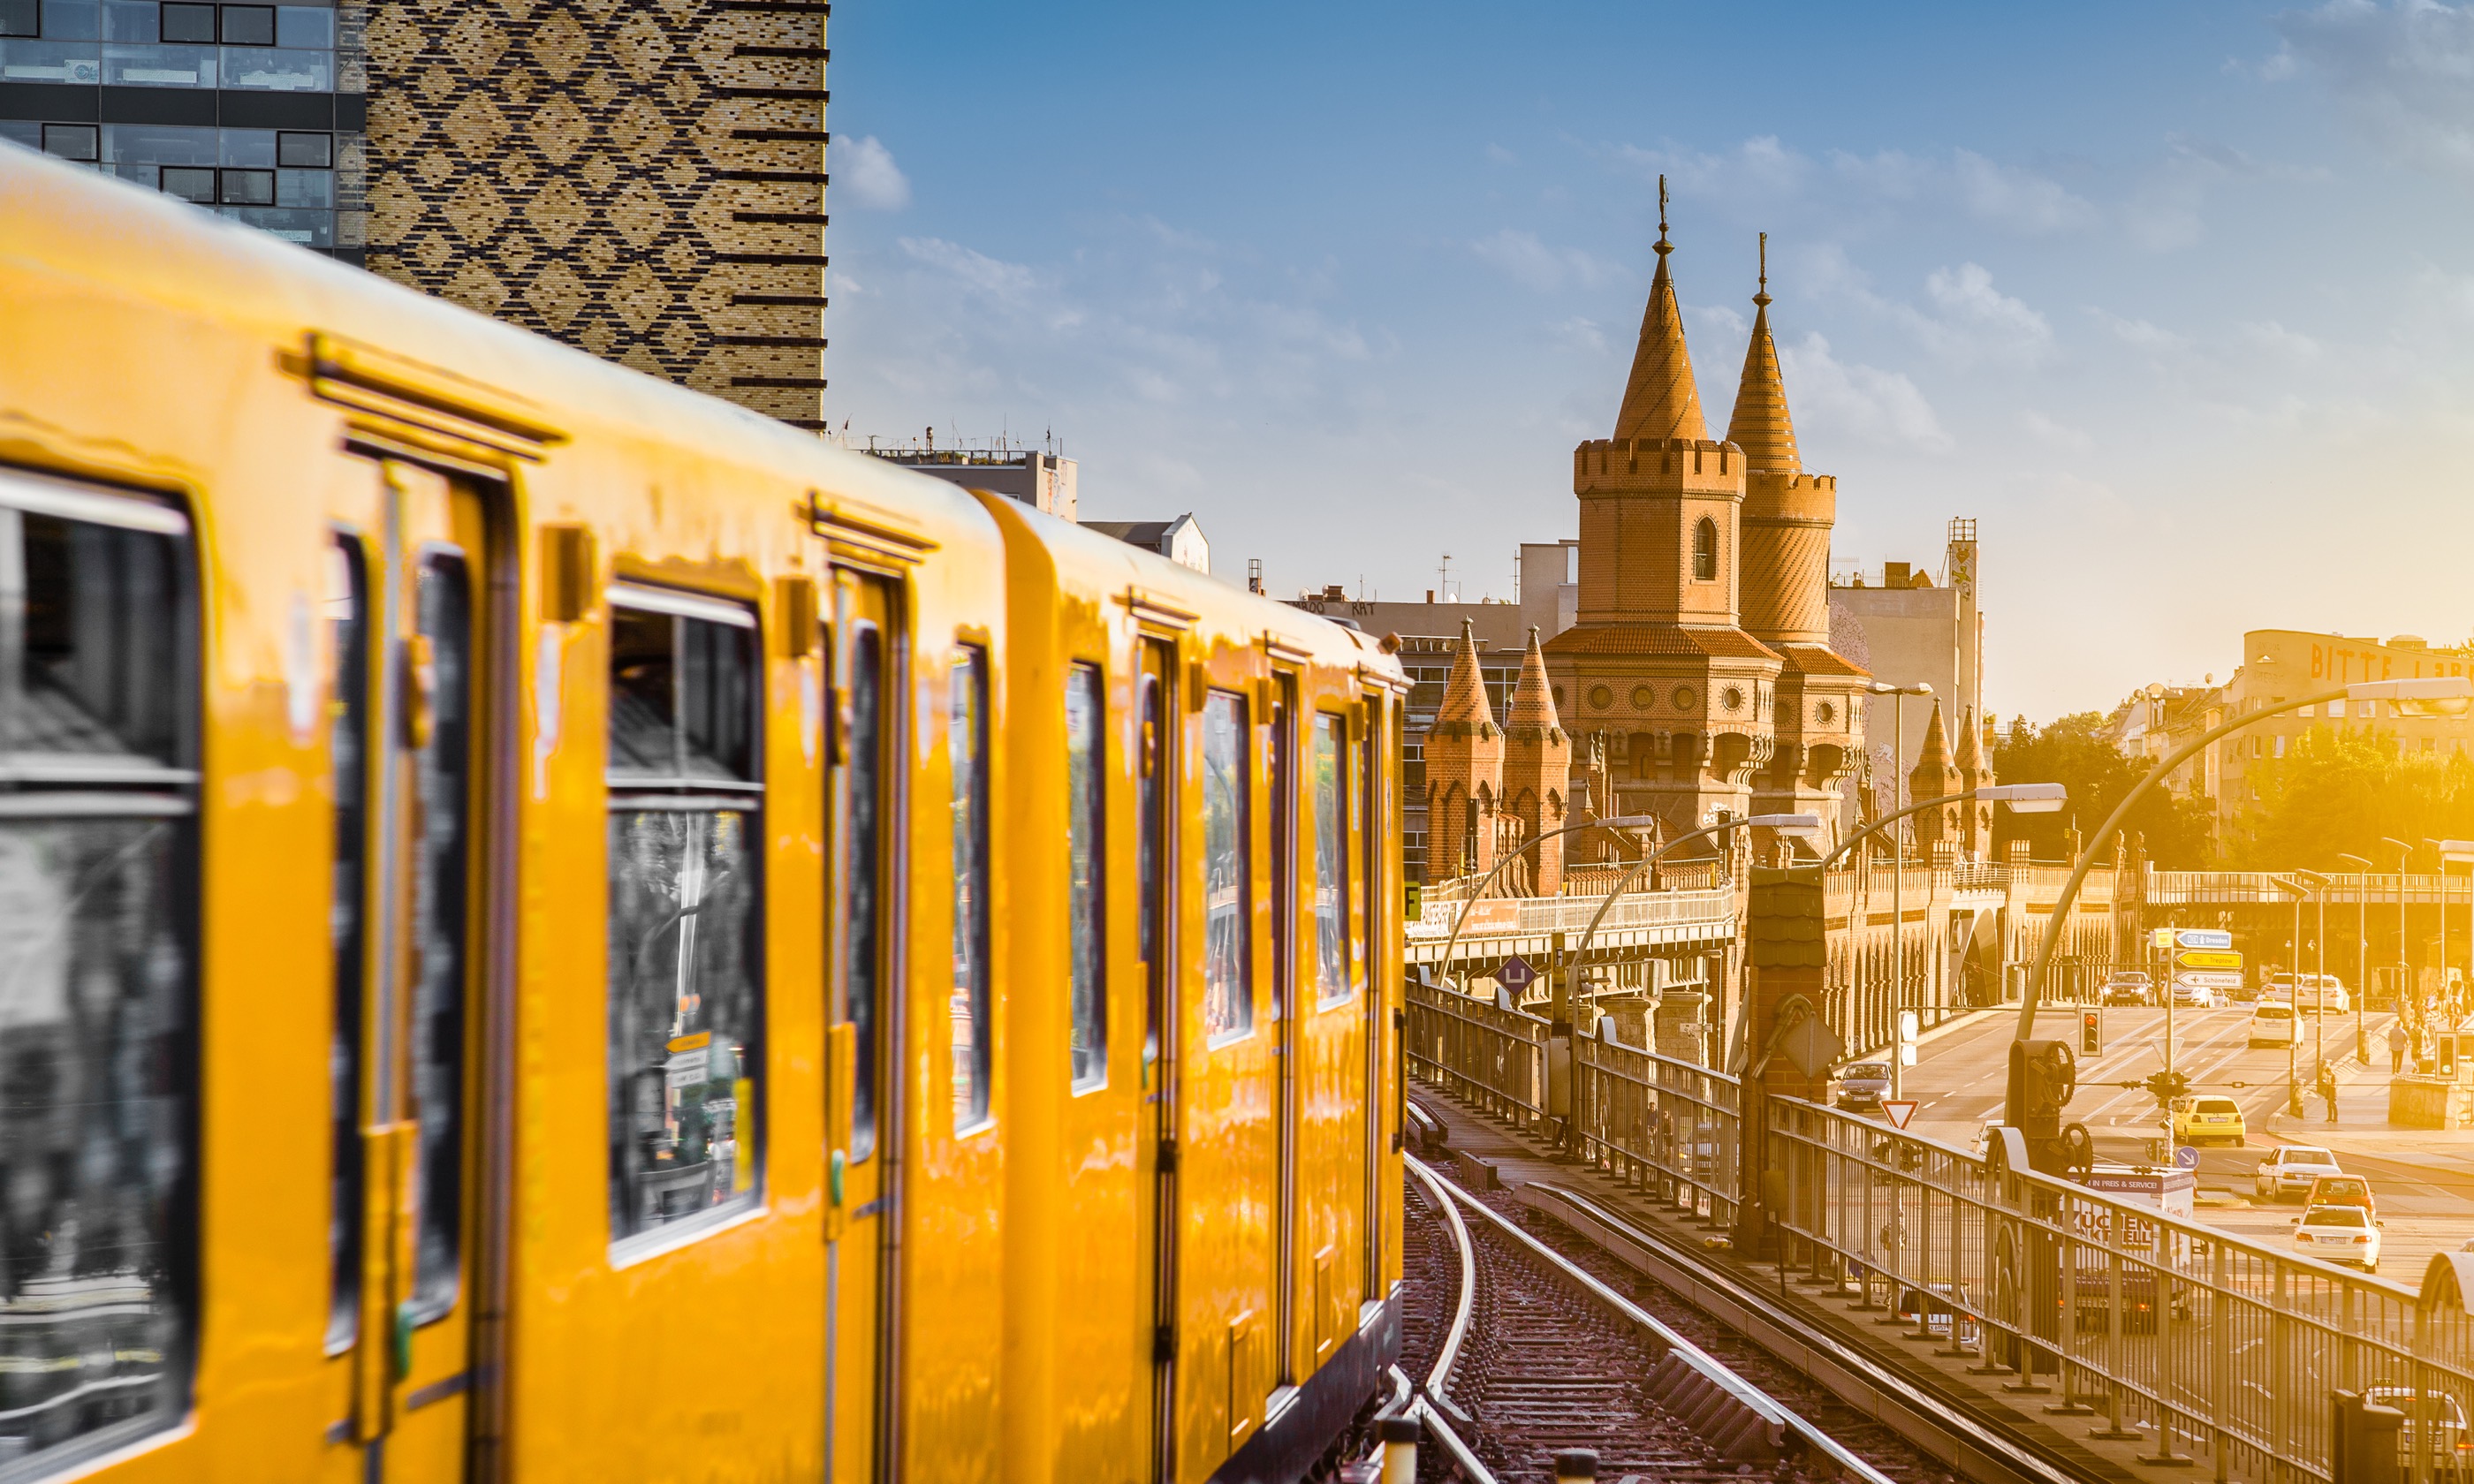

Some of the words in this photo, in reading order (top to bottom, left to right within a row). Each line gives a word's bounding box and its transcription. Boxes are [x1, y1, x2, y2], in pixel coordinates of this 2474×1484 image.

[2311, 642, 2392, 683] BITTE
[1404, 887, 1418, 916] F
[1505, 967, 1526, 983] U
